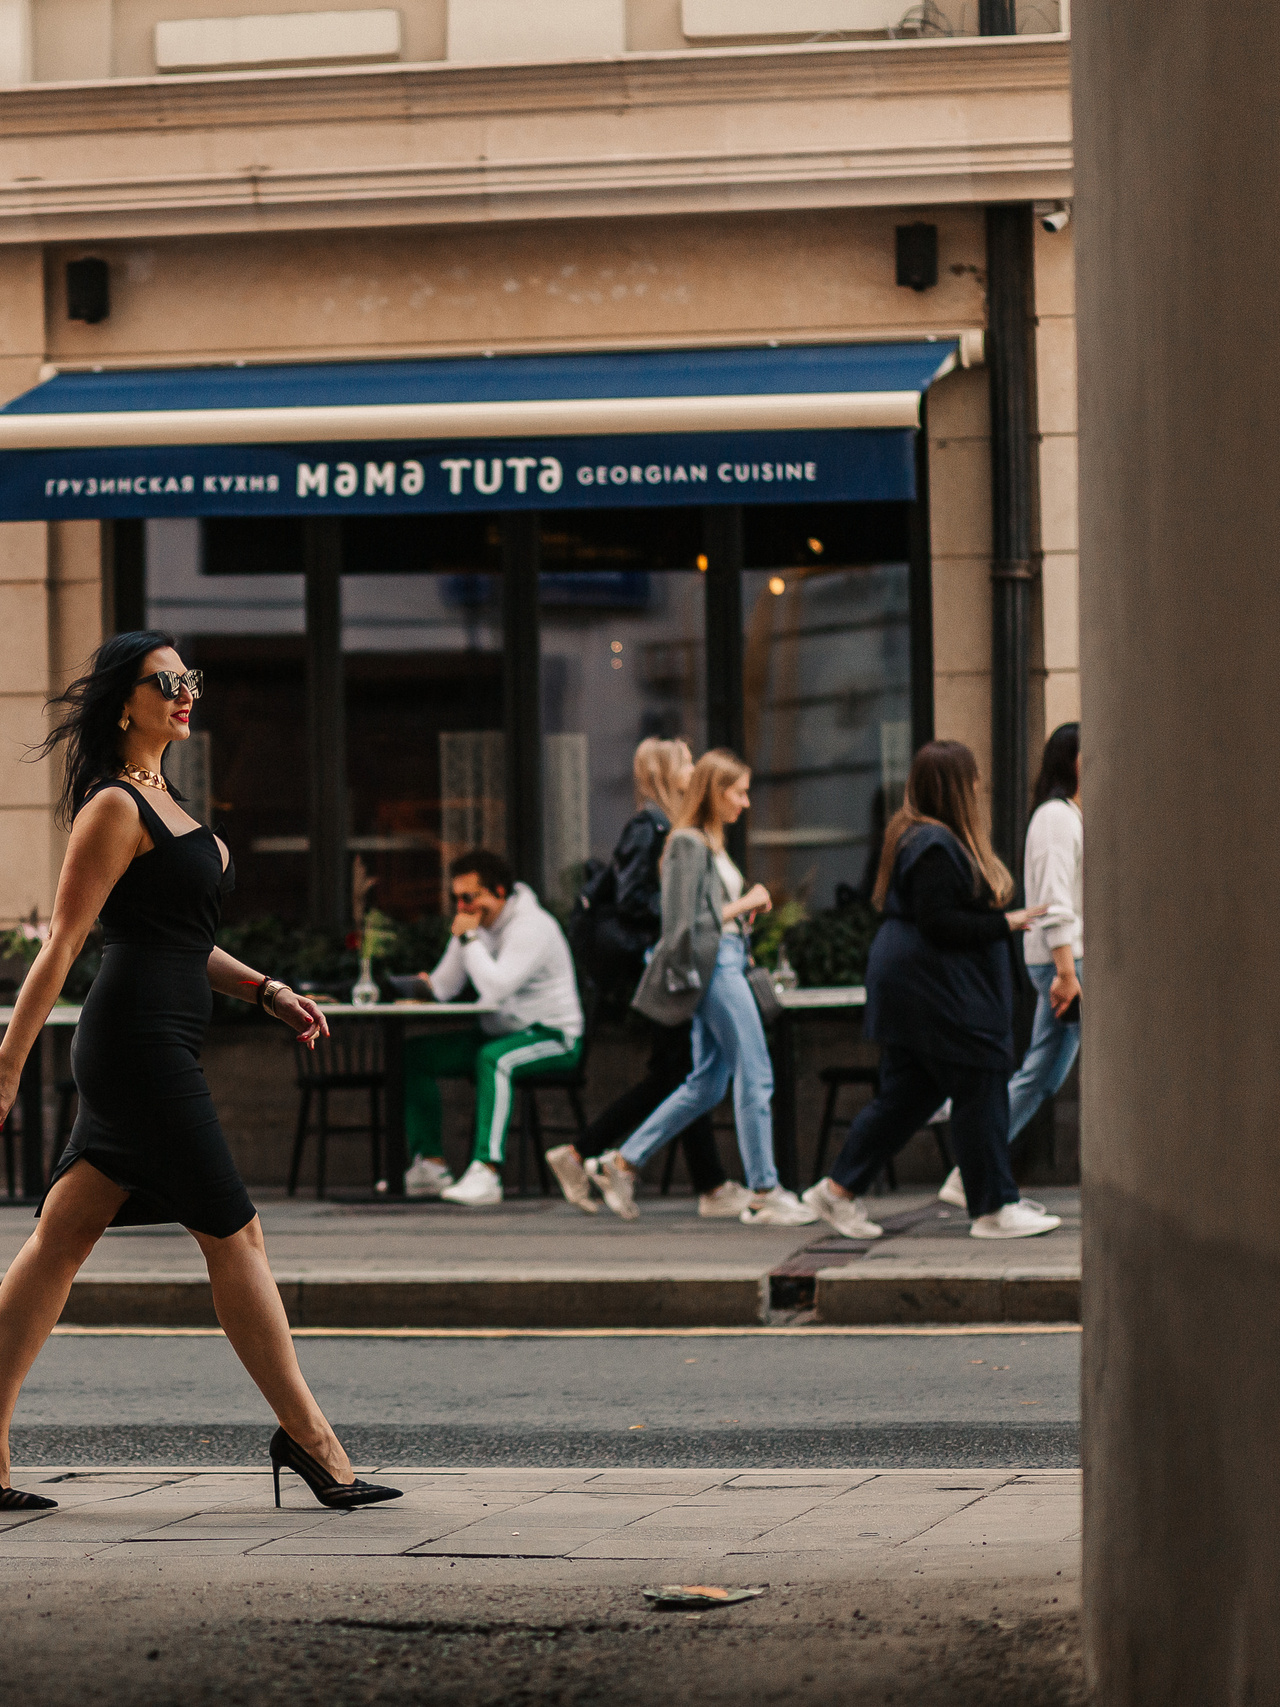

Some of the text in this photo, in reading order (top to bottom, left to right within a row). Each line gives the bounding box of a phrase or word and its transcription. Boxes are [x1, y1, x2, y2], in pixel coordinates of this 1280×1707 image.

[576, 461, 817, 485] GEORGIAN CUISINE
[45, 475, 279, 496] ГРУЗИНСКАЯ КУХНЯ
